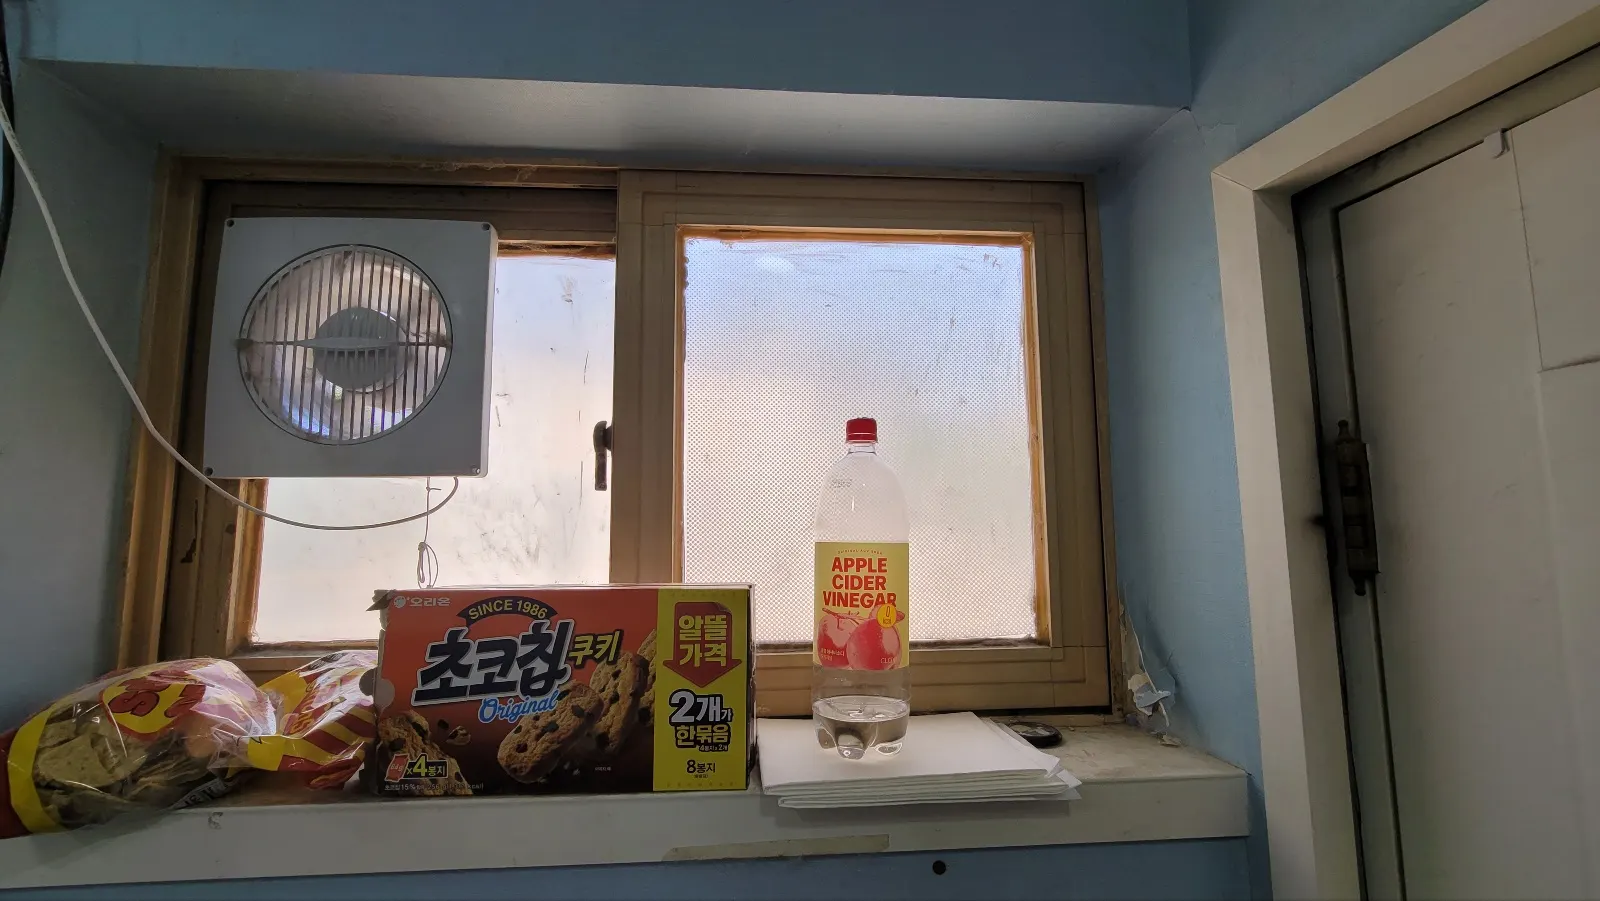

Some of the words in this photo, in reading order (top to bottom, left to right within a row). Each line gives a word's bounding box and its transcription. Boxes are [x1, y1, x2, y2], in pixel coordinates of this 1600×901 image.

[831, 557, 887, 572] APPLE
[832, 574, 886, 590] CIDER
[409, 596, 451, 607] 오리온
[469, 599, 513, 620] SINCE
[516, 599, 548, 619] 1986
[822, 591, 897, 608] VINEGAR
[678, 614, 727, 641] 알뜰
[413, 620, 574, 704] 초코칩
[568, 630, 621, 666] 쿠키
[679, 643, 727, 667] 가격
[479, 690, 559, 723] Original
[676, 724, 730, 747] 한묶음
[687, 759, 716, 773] 8봉지
